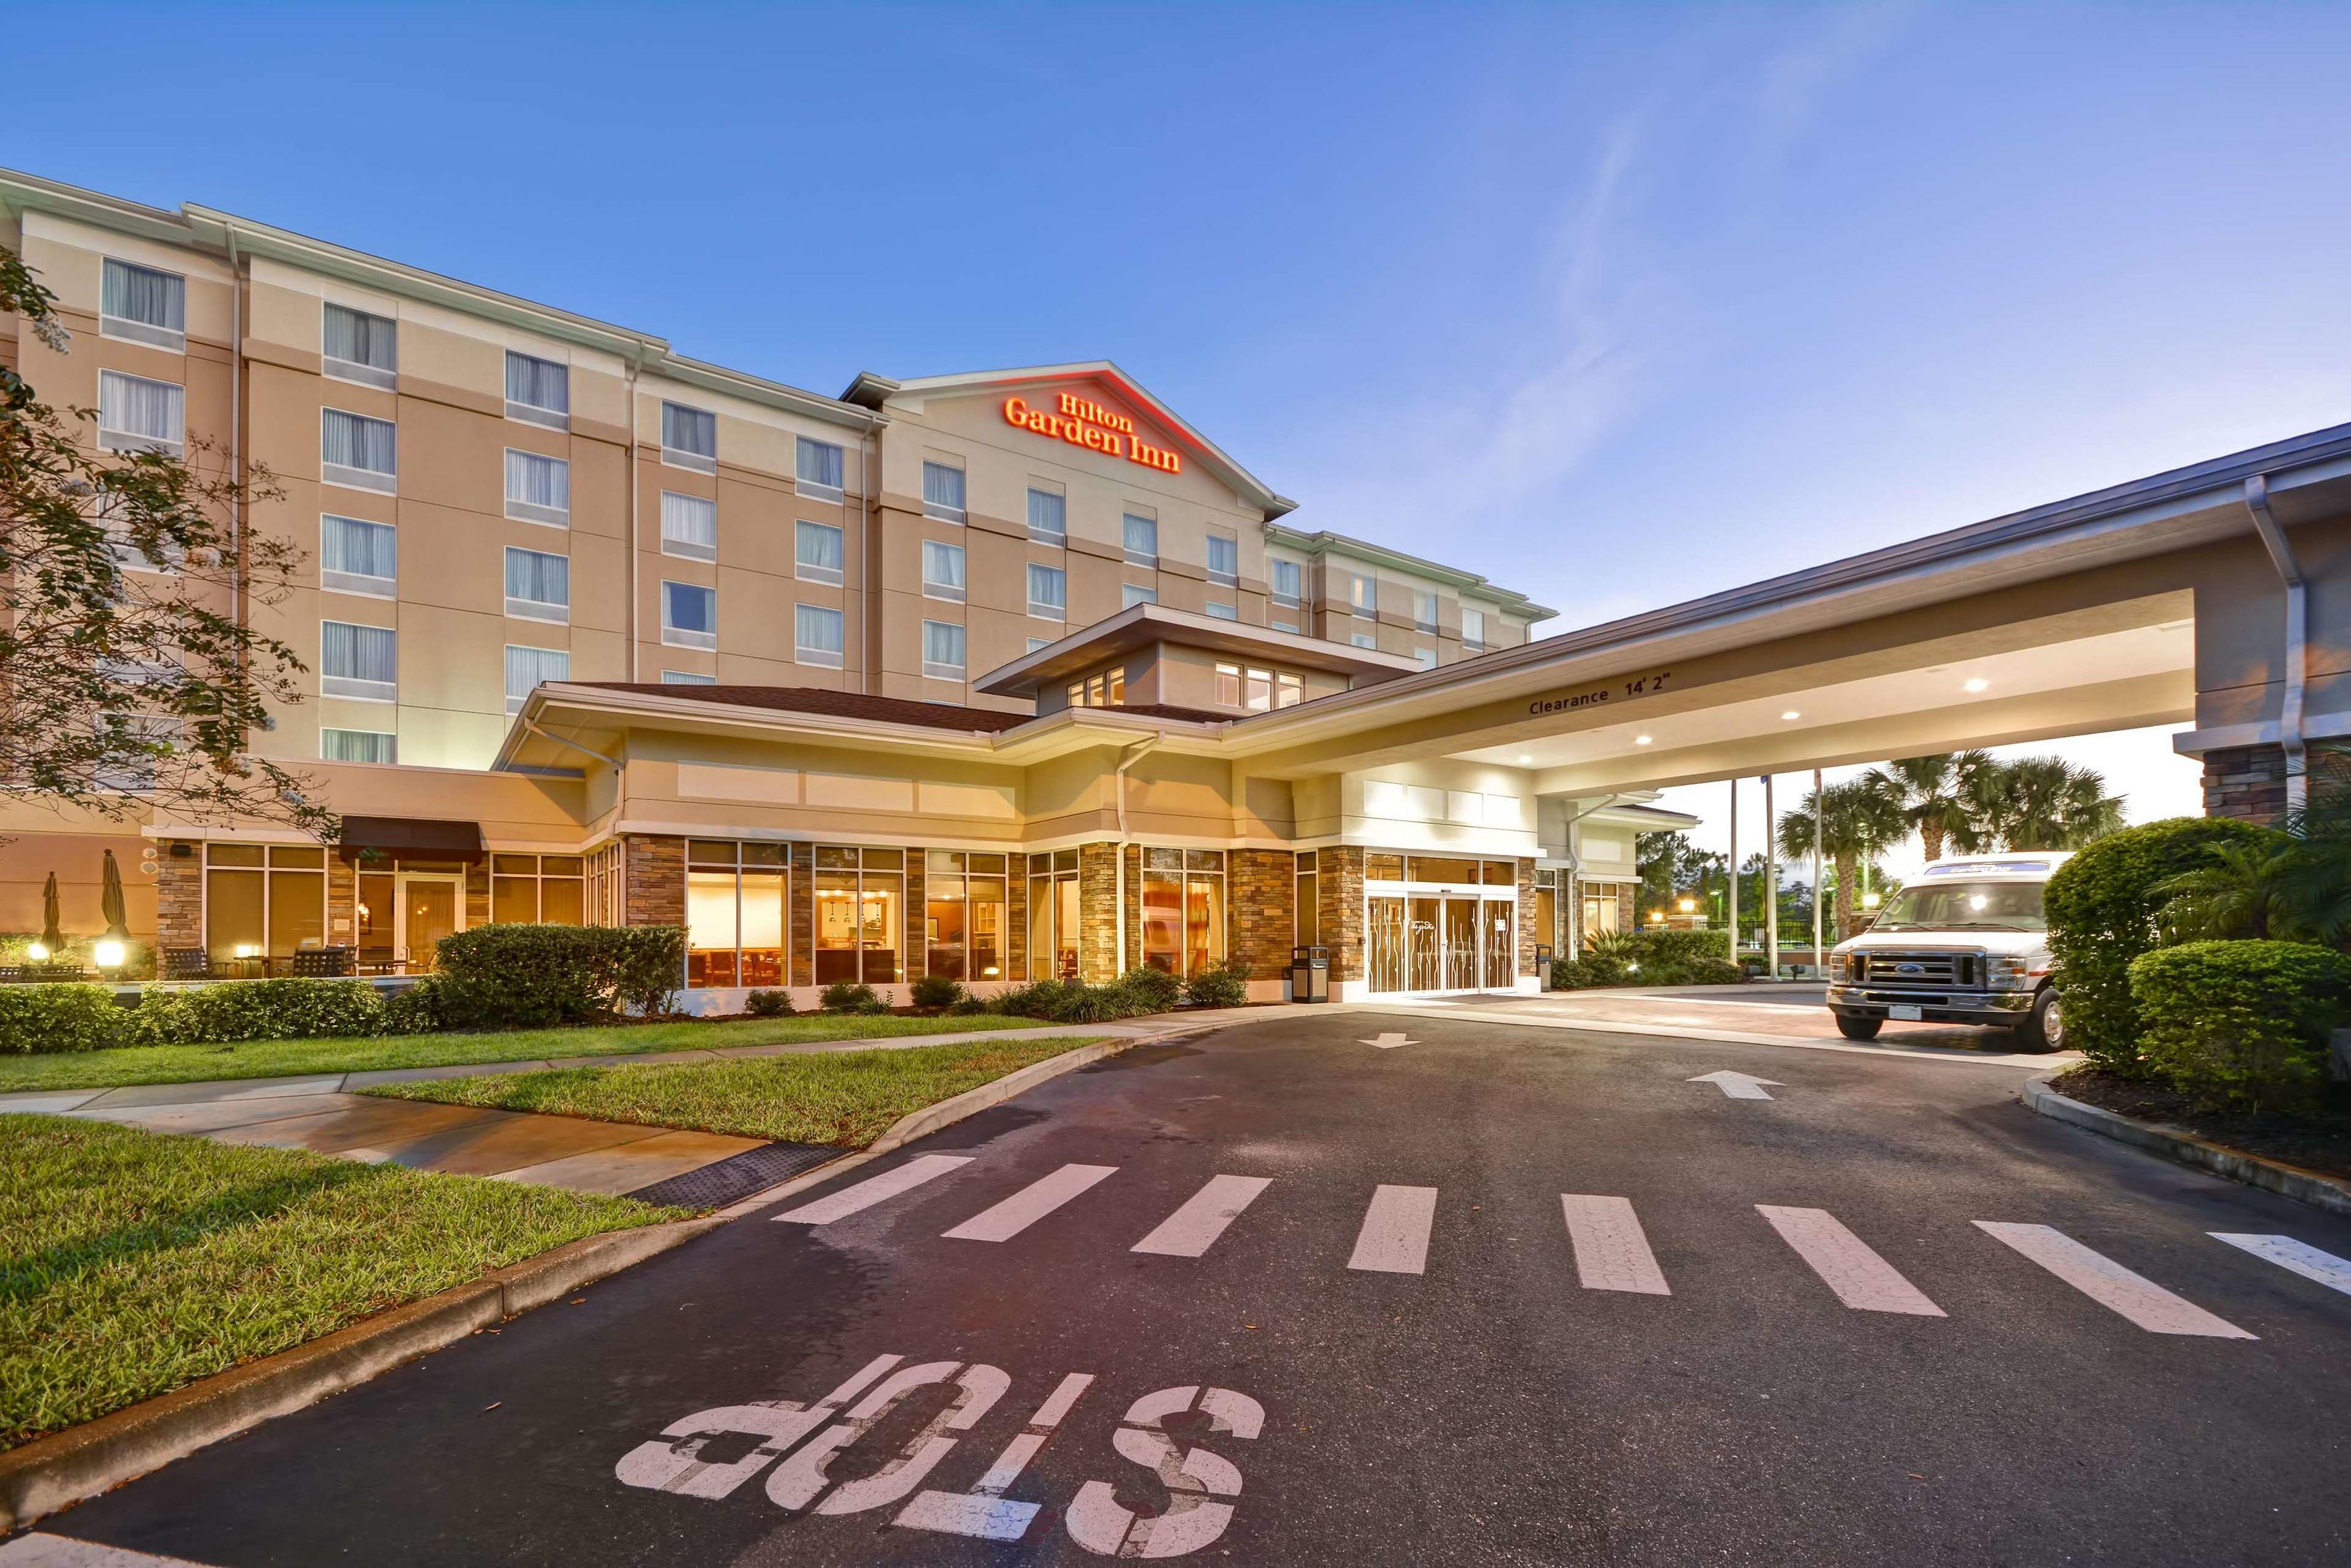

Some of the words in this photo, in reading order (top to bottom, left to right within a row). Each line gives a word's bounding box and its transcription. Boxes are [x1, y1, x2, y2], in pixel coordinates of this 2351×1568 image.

[1004, 397, 1122, 457] Garden
[1128, 435, 1181, 474] Inn
[1059, 393, 1133, 433] Hilton
[1529, 690, 1609, 715] Clearance
[1625, 677, 1647, 695] 14'
[1653, 672, 1671, 691] 2"
[615, 1353, 1266, 1559] STOP
